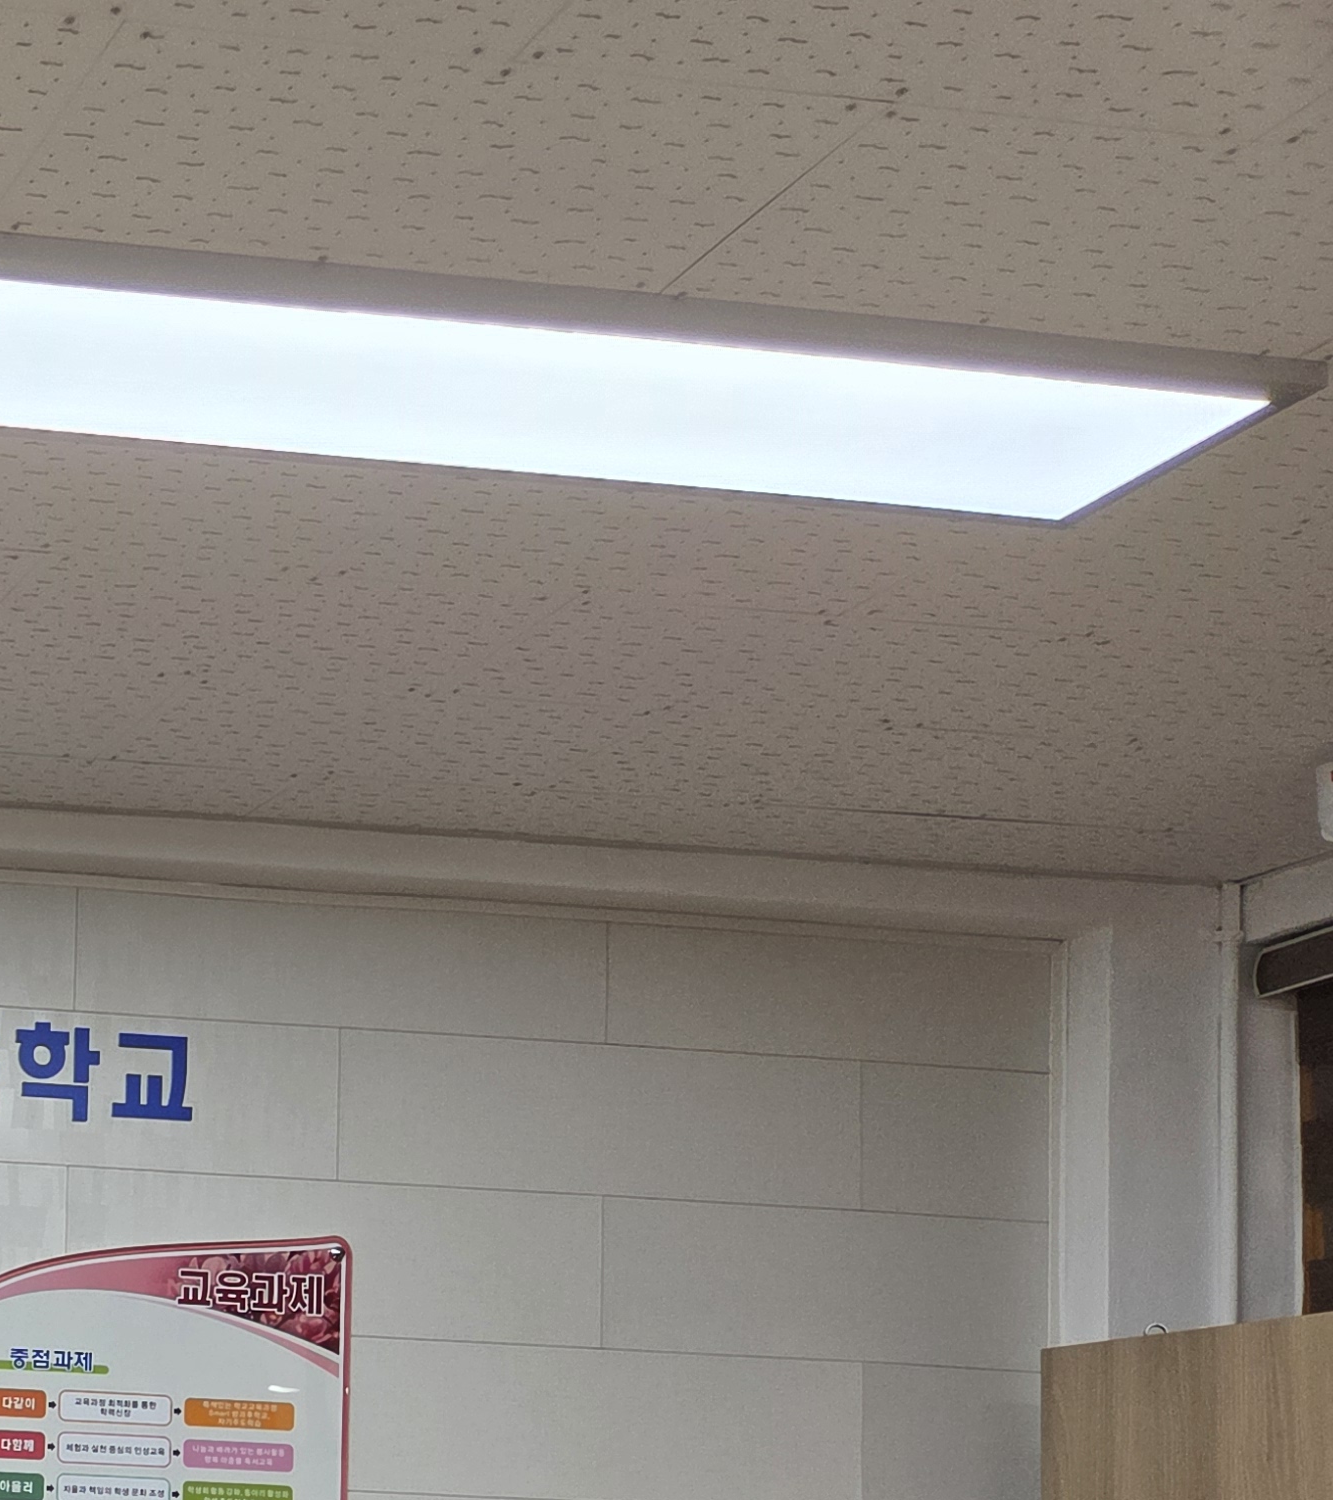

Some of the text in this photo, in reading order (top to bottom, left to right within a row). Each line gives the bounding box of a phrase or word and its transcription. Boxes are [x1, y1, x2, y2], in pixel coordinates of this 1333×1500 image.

[176, 1267, 324, 1316] 교육과제
[9, 1348, 93, 1373] 중점과제
[2, 1396, 35, 1410] 다같이
[1, 1439, 35, 1452] 다함께
[0, 1480, 33, 1493] 아울러
